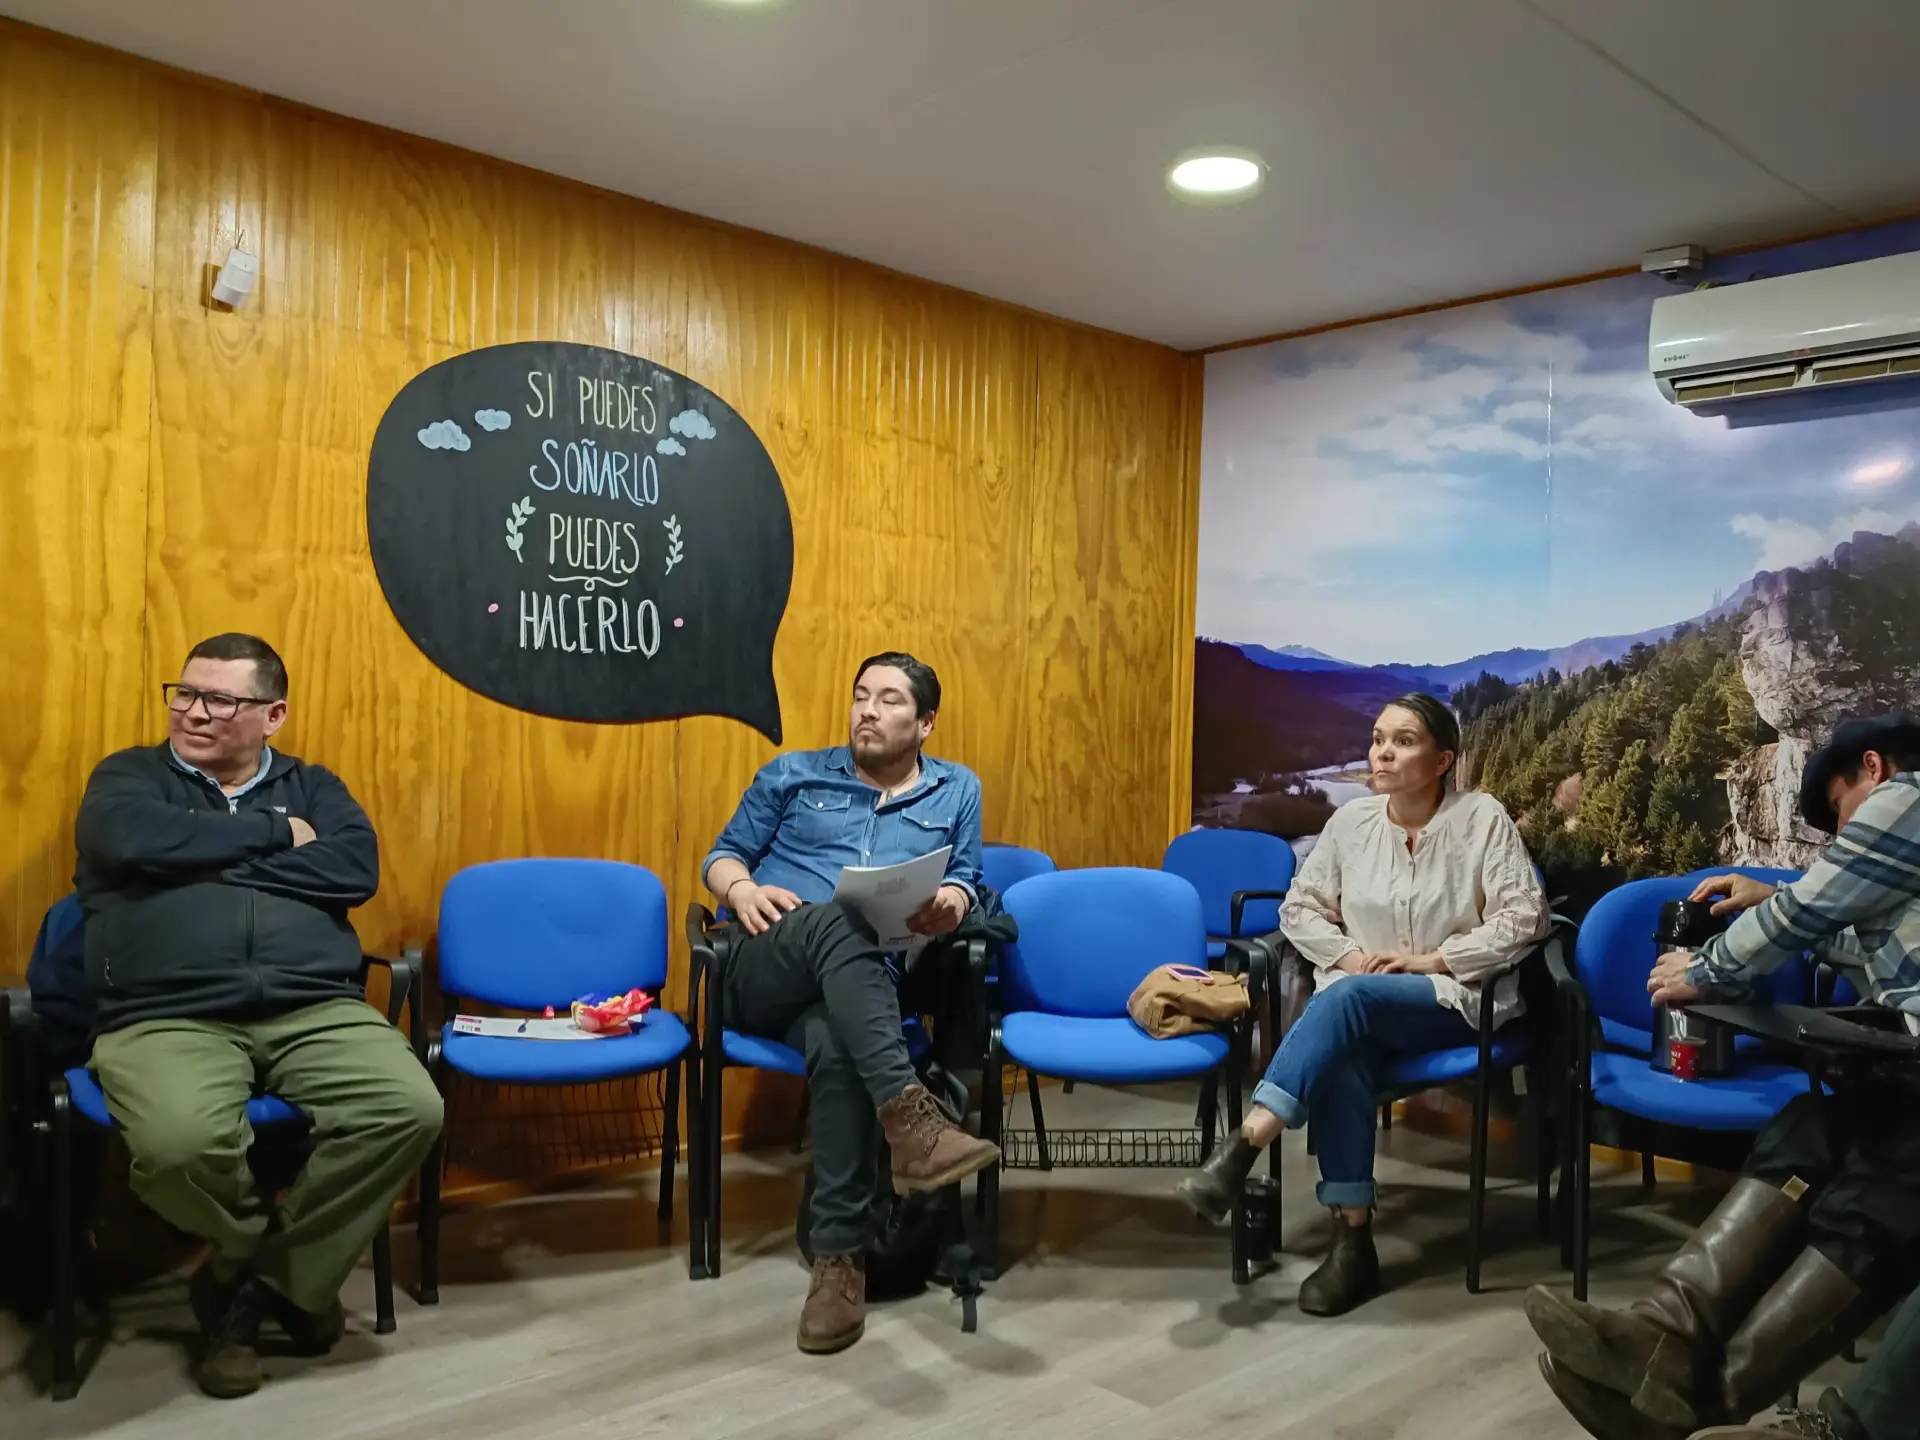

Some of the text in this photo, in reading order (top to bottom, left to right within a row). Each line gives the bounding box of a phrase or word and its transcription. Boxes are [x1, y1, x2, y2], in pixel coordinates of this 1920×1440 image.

[526, 371, 657, 434] SI PUEDES
[529, 438, 659, 506] SOÑARLO
[548, 513, 640, 574] PUEDES
[518, 590, 661, 660] HACERLO
